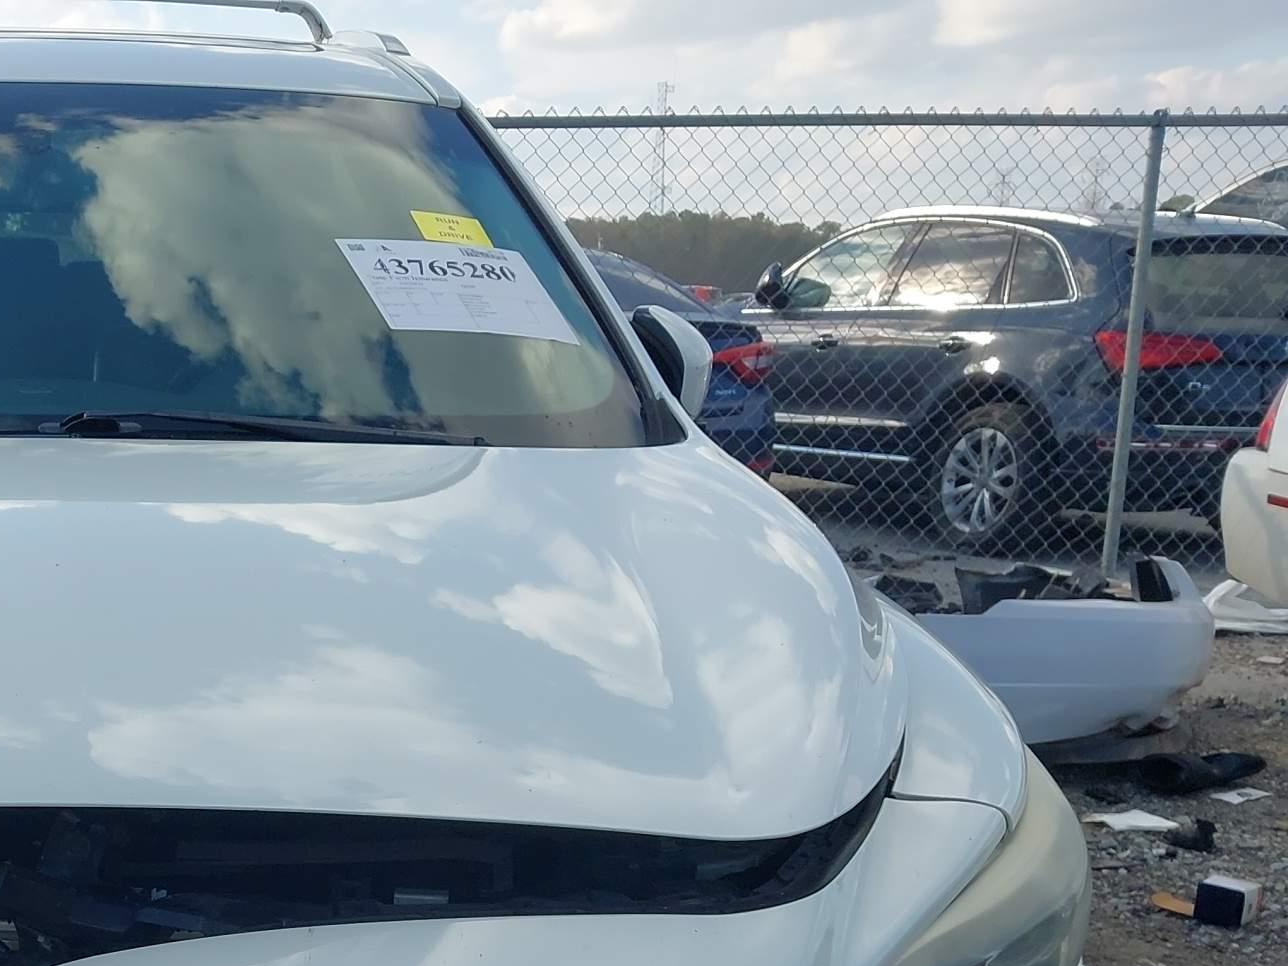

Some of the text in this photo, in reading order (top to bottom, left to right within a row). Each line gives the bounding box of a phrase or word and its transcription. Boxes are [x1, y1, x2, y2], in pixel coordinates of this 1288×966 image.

[435, 217, 459, 225] RUN
[438, 231, 472, 241] DRIVE
[373, 258, 516, 283] 43765280
